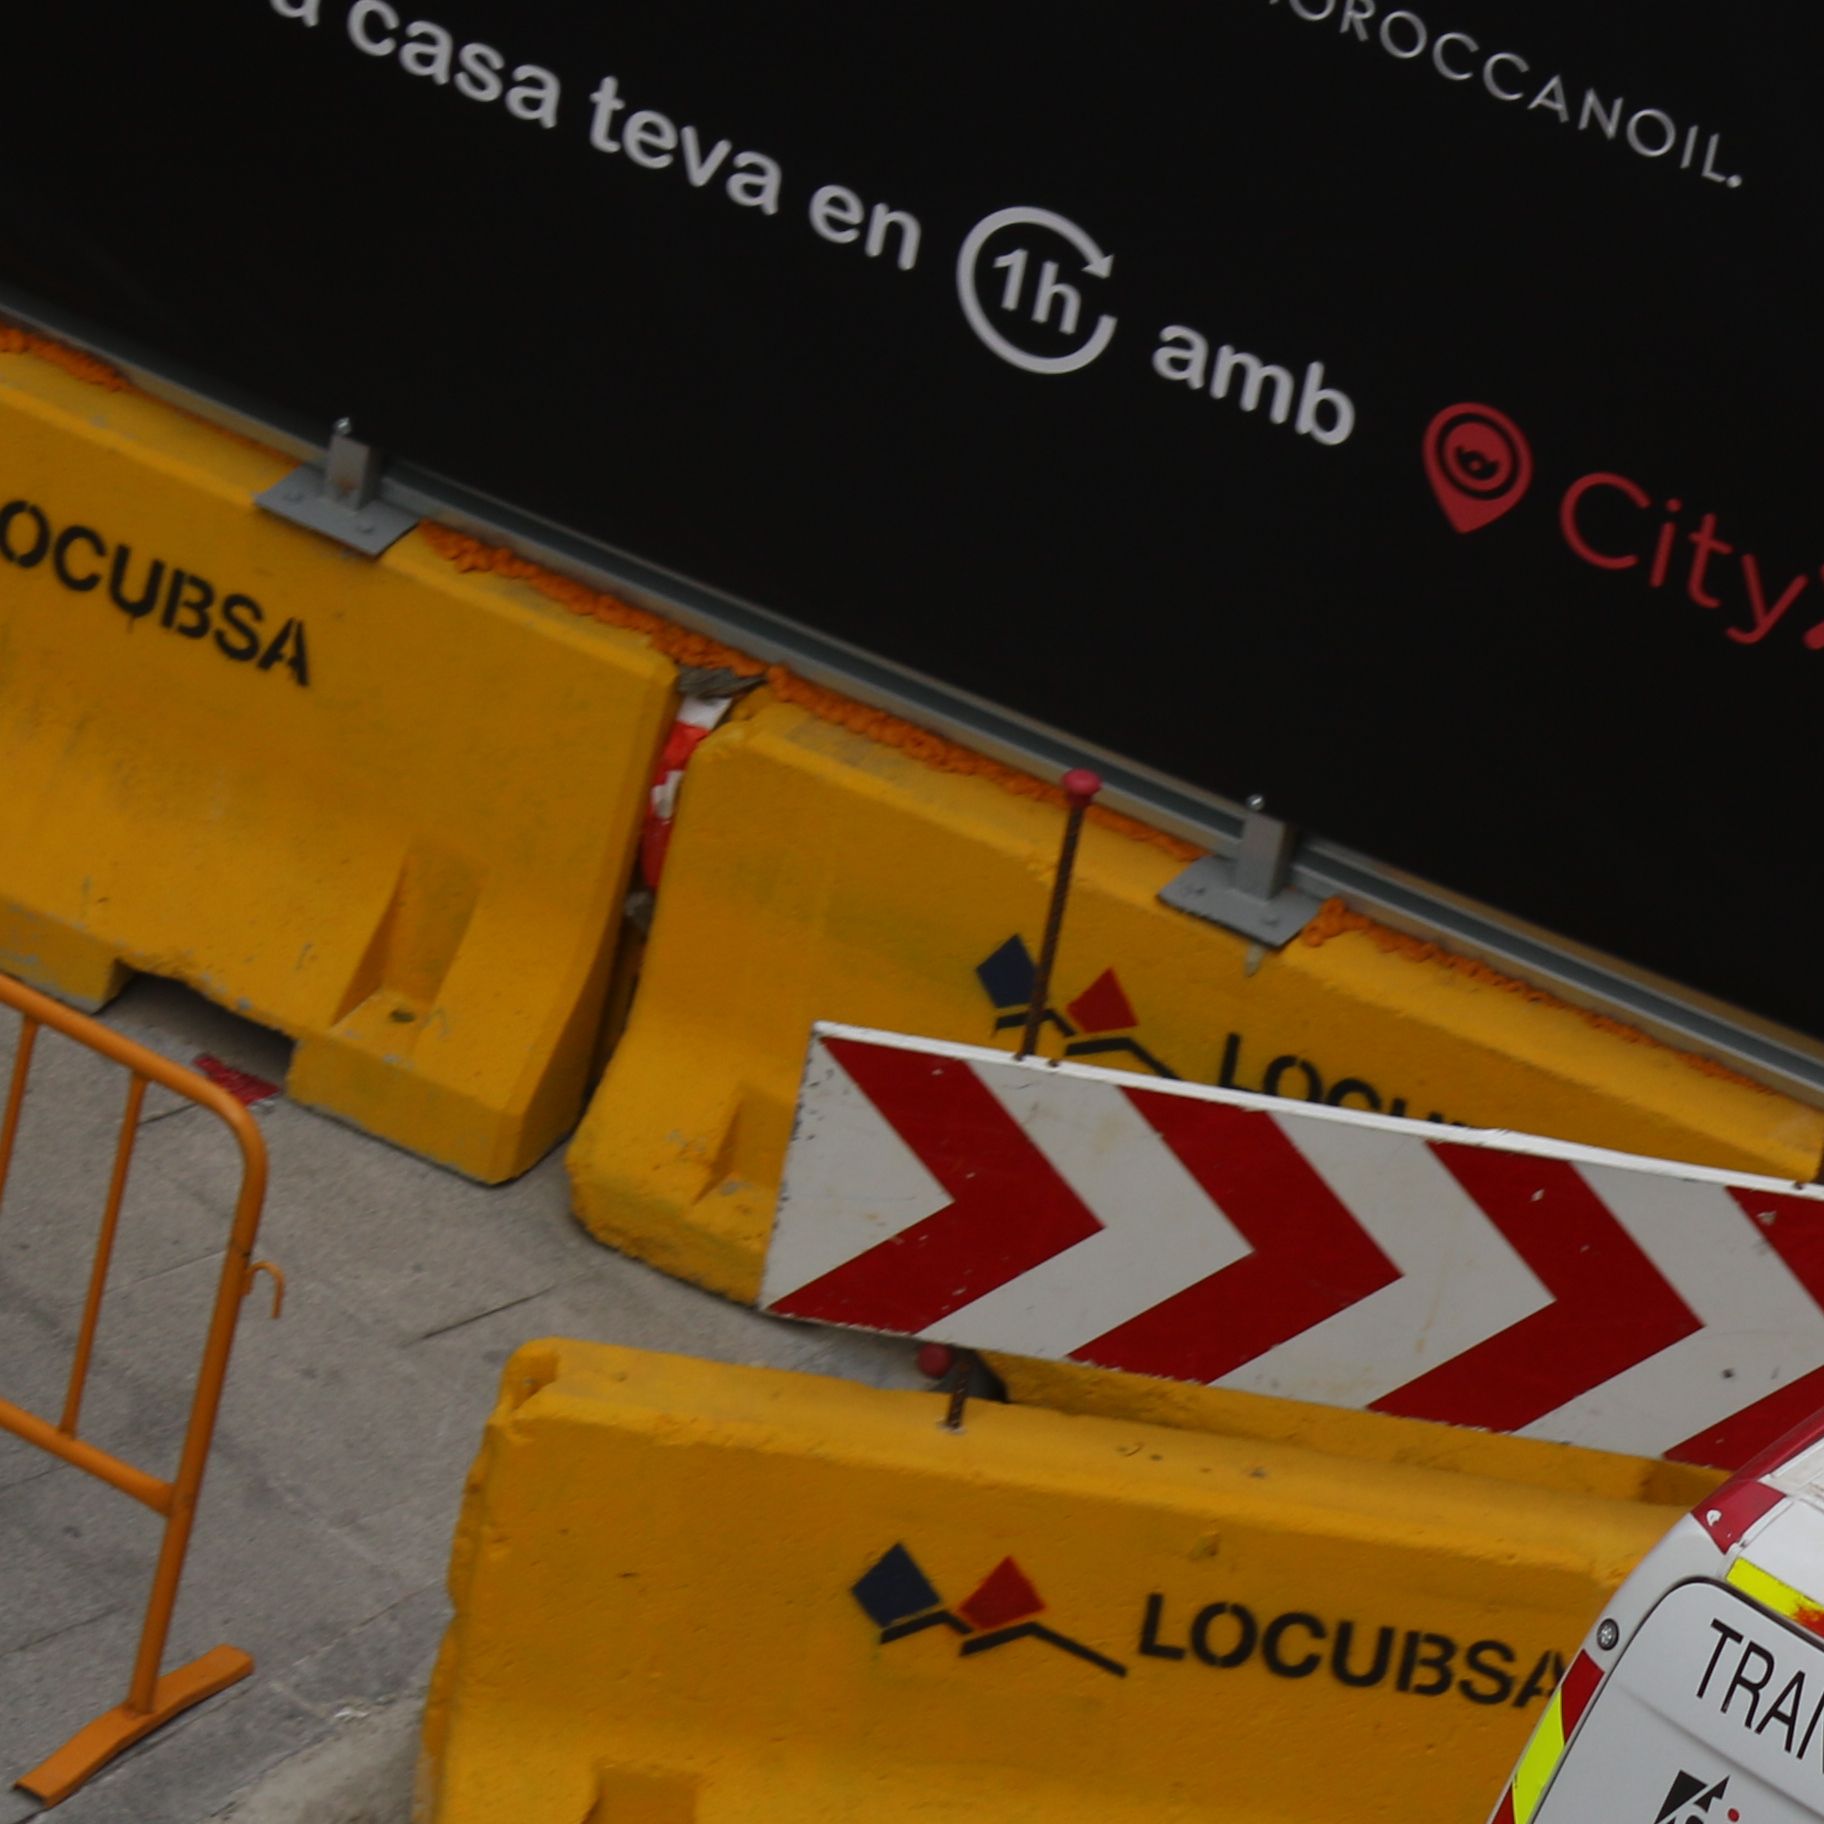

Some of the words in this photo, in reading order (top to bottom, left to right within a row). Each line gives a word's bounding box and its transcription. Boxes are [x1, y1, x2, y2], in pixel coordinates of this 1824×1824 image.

[346, 0, 561, 128] casa
[589, 76, 783, 214] teva
[808, 184, 922, 271] en
[991, 250, 1082, 334] 1h
[1151, 324, 1356, 446] amb
[1139, 1593, 1566, 1709] LOCUBSA
